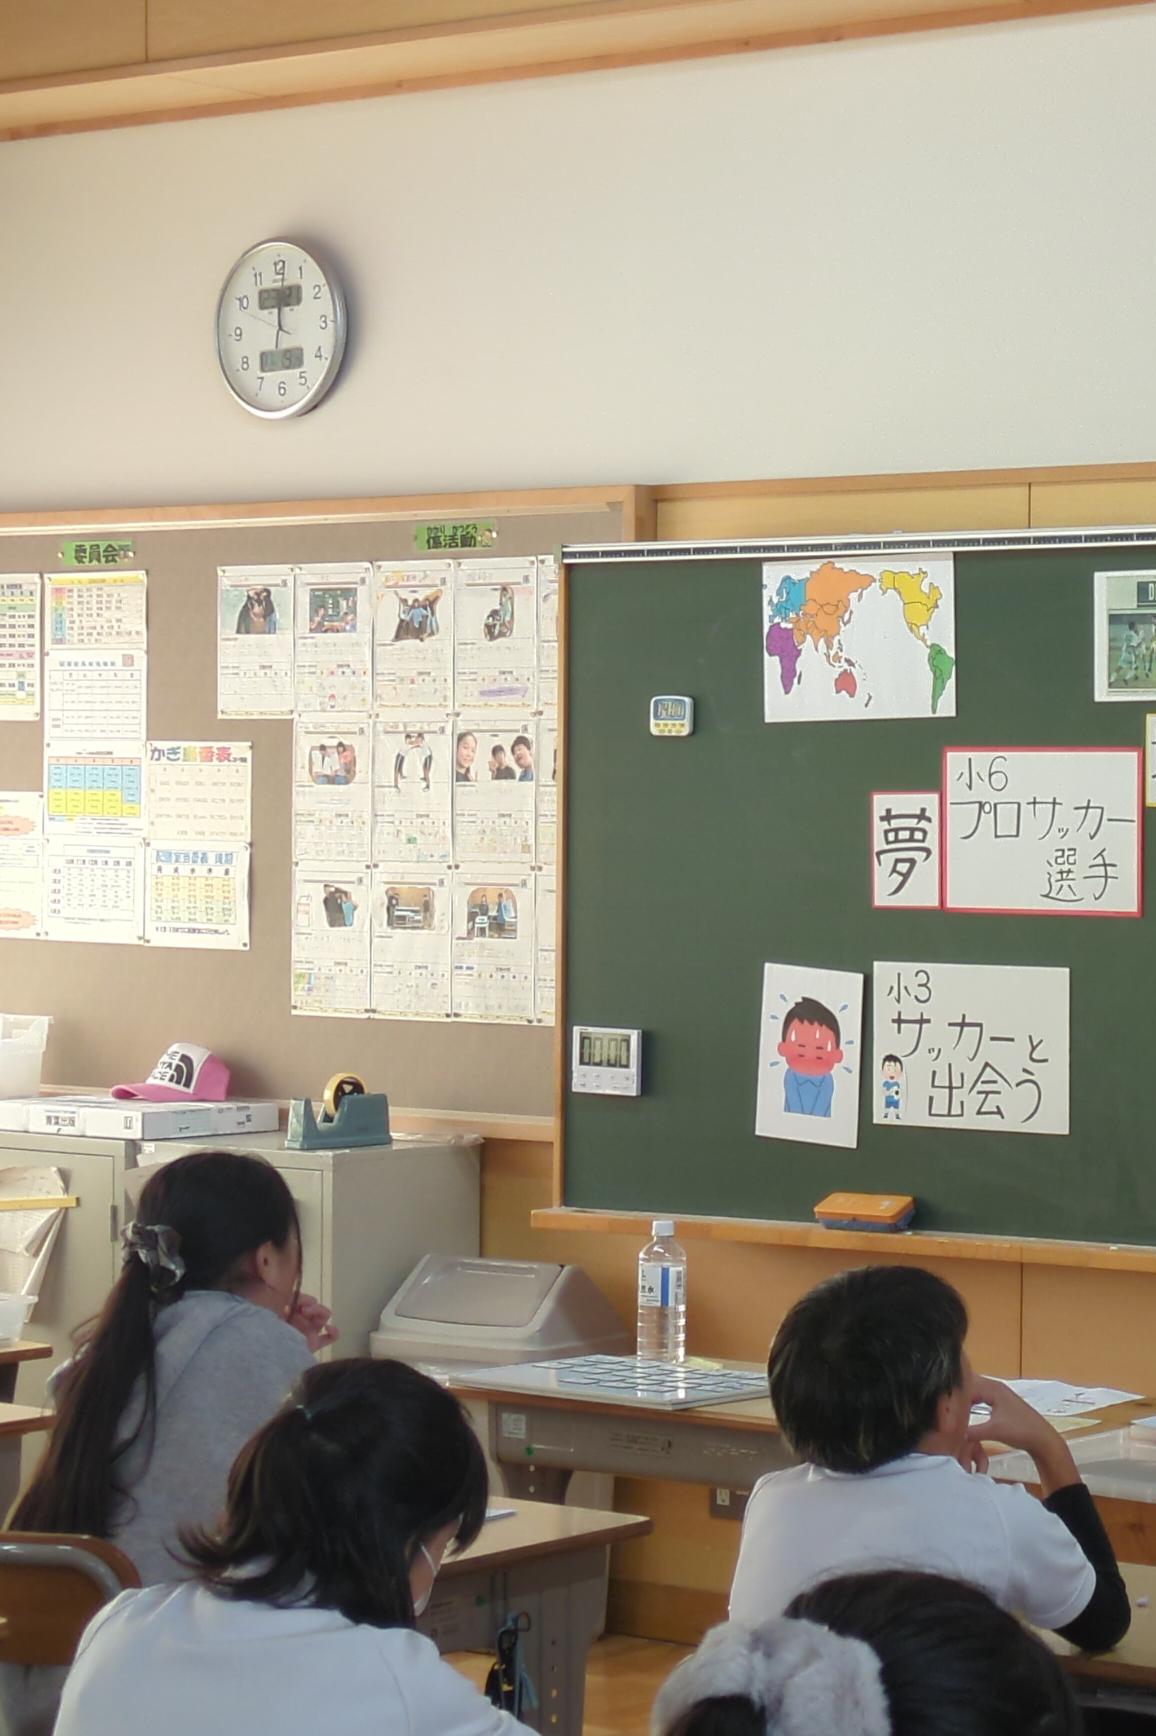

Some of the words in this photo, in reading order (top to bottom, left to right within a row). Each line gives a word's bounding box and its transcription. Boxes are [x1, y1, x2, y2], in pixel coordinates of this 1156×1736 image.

[273, 260, 286, 275] 12
[298, 266, 304, 279] 1
[253, 272, 263, 286] 11
[312, 285, 322, 300] 2
[237, 295, 250, 310] 10
[319, 314, 328, 330] 3
[234, 326, 243, 342] 9
[314, 346, 323, 361] 4
[240, 356, 250, 371] 8
[256, 376, 265, 391] 7
[298, 371, 308, 386] 5
[278, 381, 287, 396] 6
[74, 544, 118, 564] 委員会
[957, 756, 1008, 791] 小6
[950, 797, 1136, 840] プロサッカー
[875, 808, 932, 896] 夢
[1040, 848, 1118, 902] 選手
[887, 969, 932, 1004] 小3
[891, 1010, 1049, 1063] サッカーと
[928, 1061, 1042, 1124] 出会う
